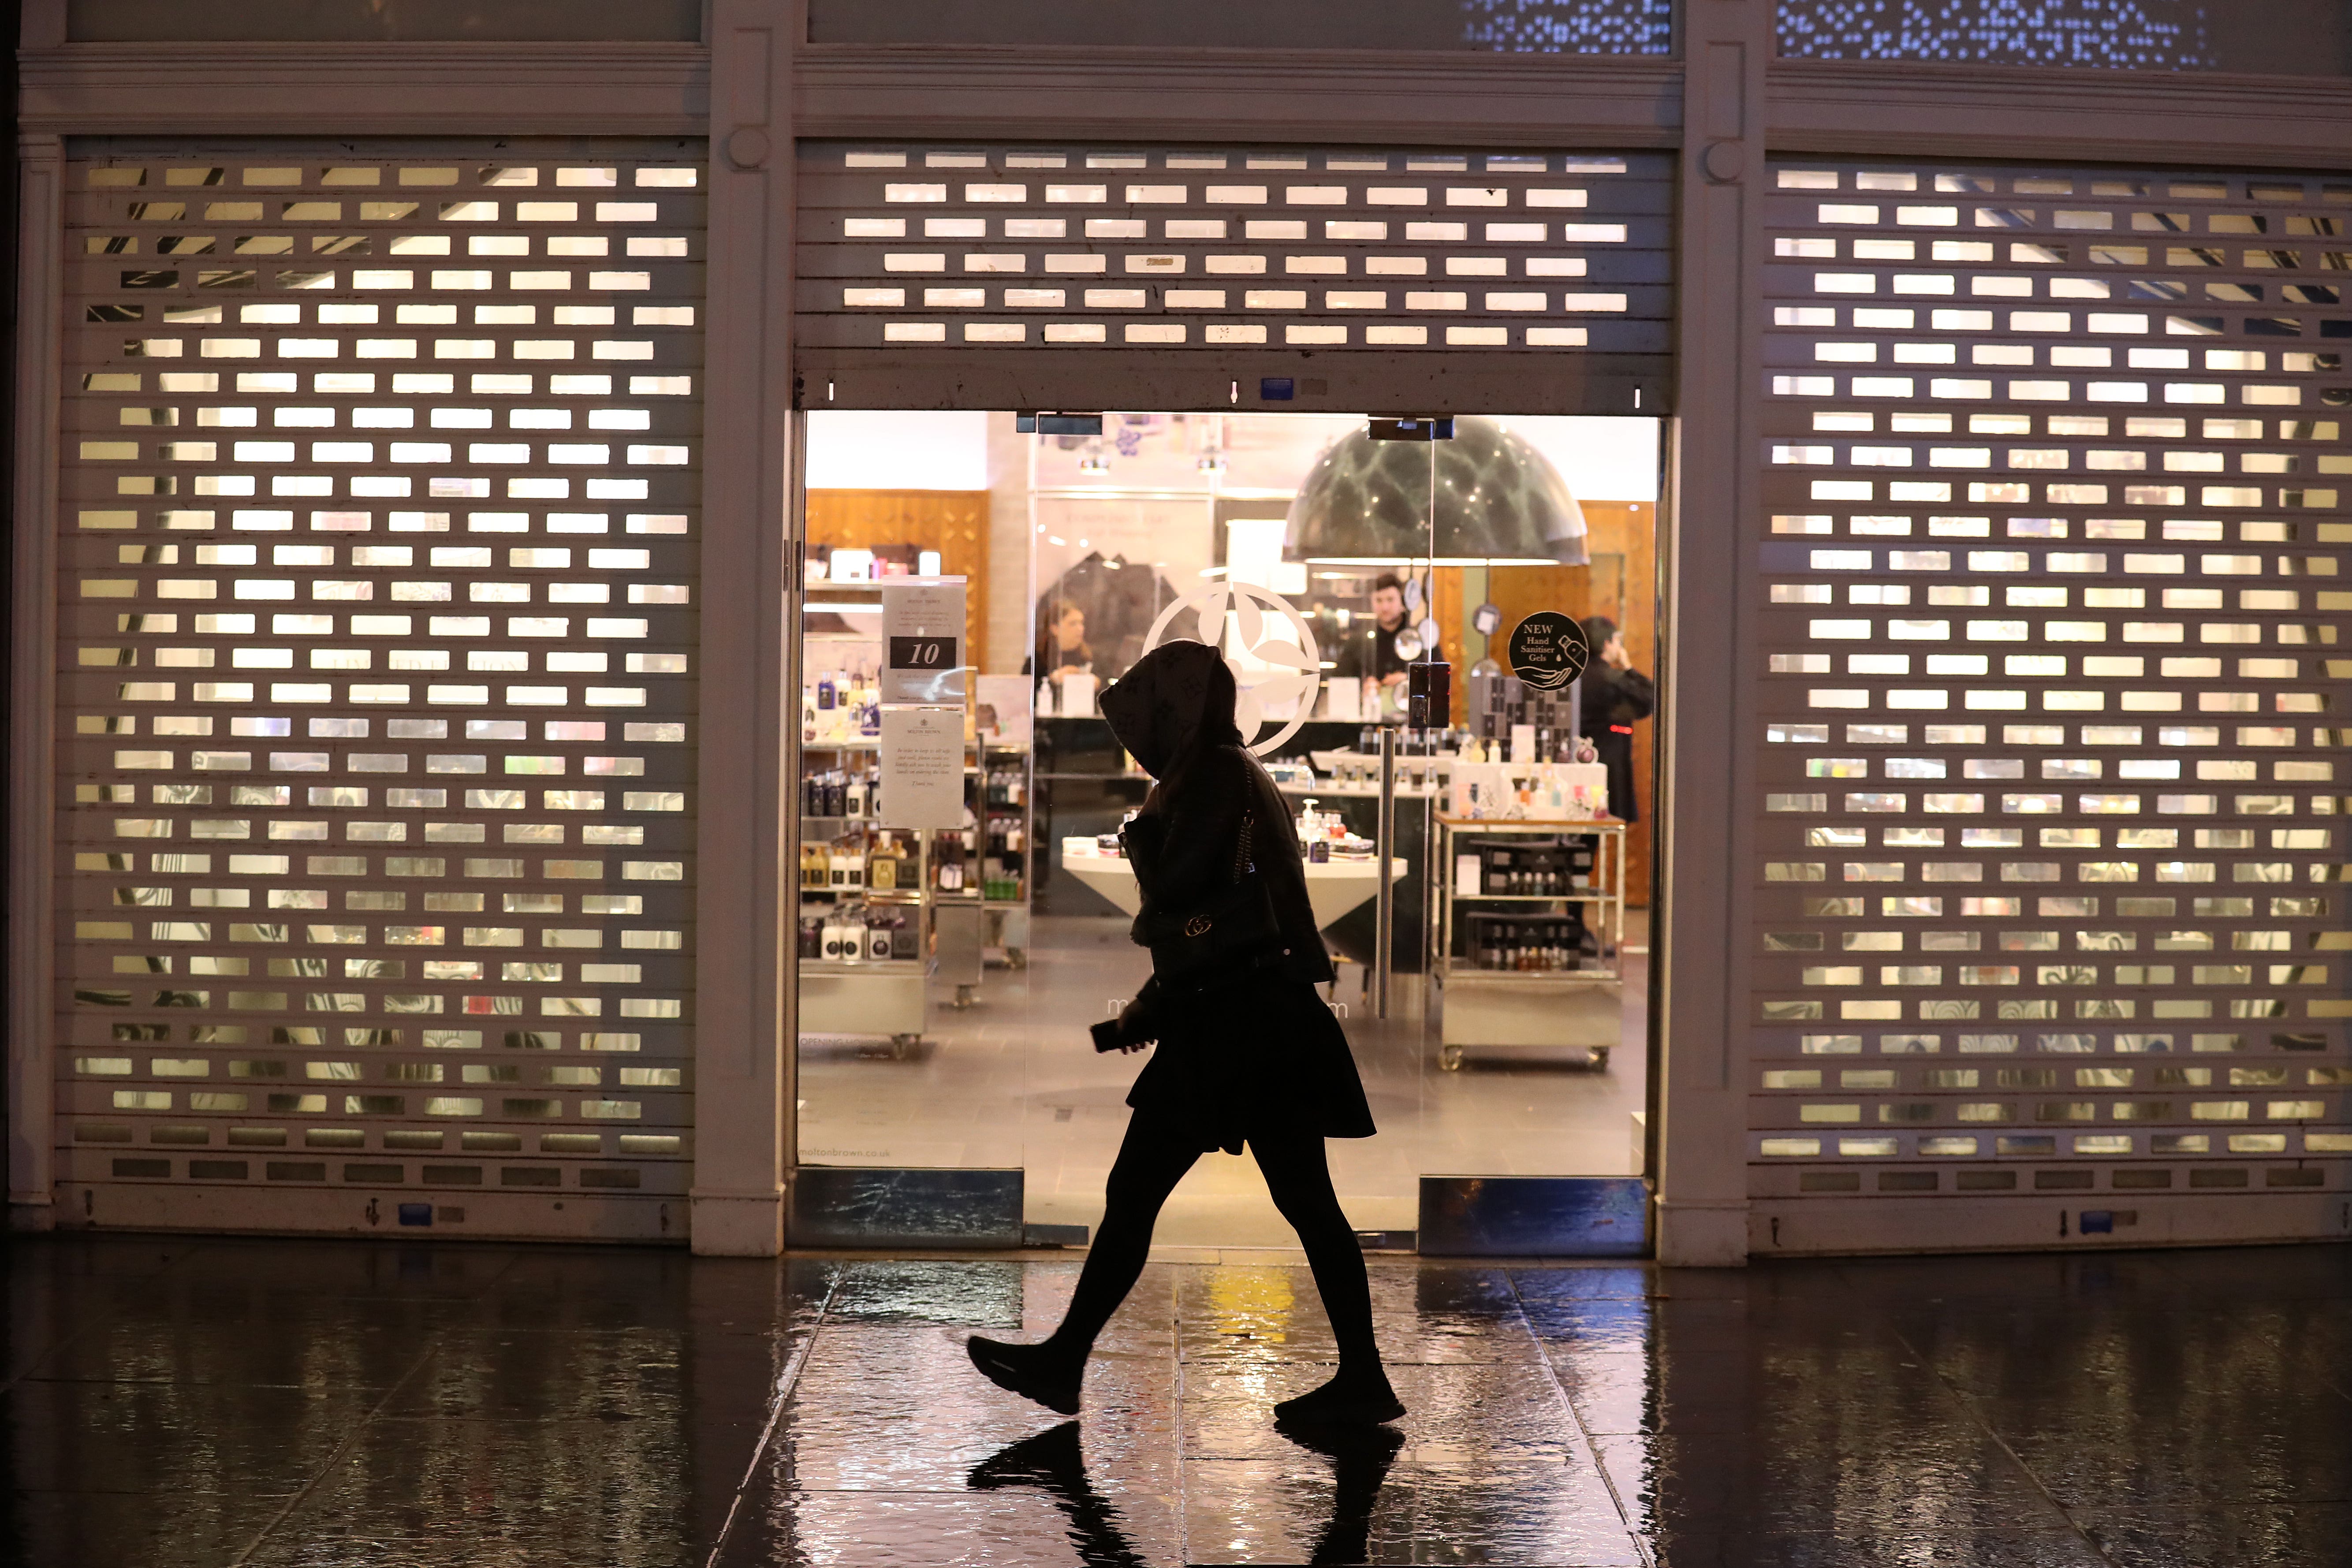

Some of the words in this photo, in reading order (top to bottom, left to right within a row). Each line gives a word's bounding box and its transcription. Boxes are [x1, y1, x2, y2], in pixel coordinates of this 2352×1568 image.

[1523, 624, 1554, 634] NEW
[908, 644, 939, 664] 10
[798, 1147, 890, 1158] moltonbrown.co.uk
